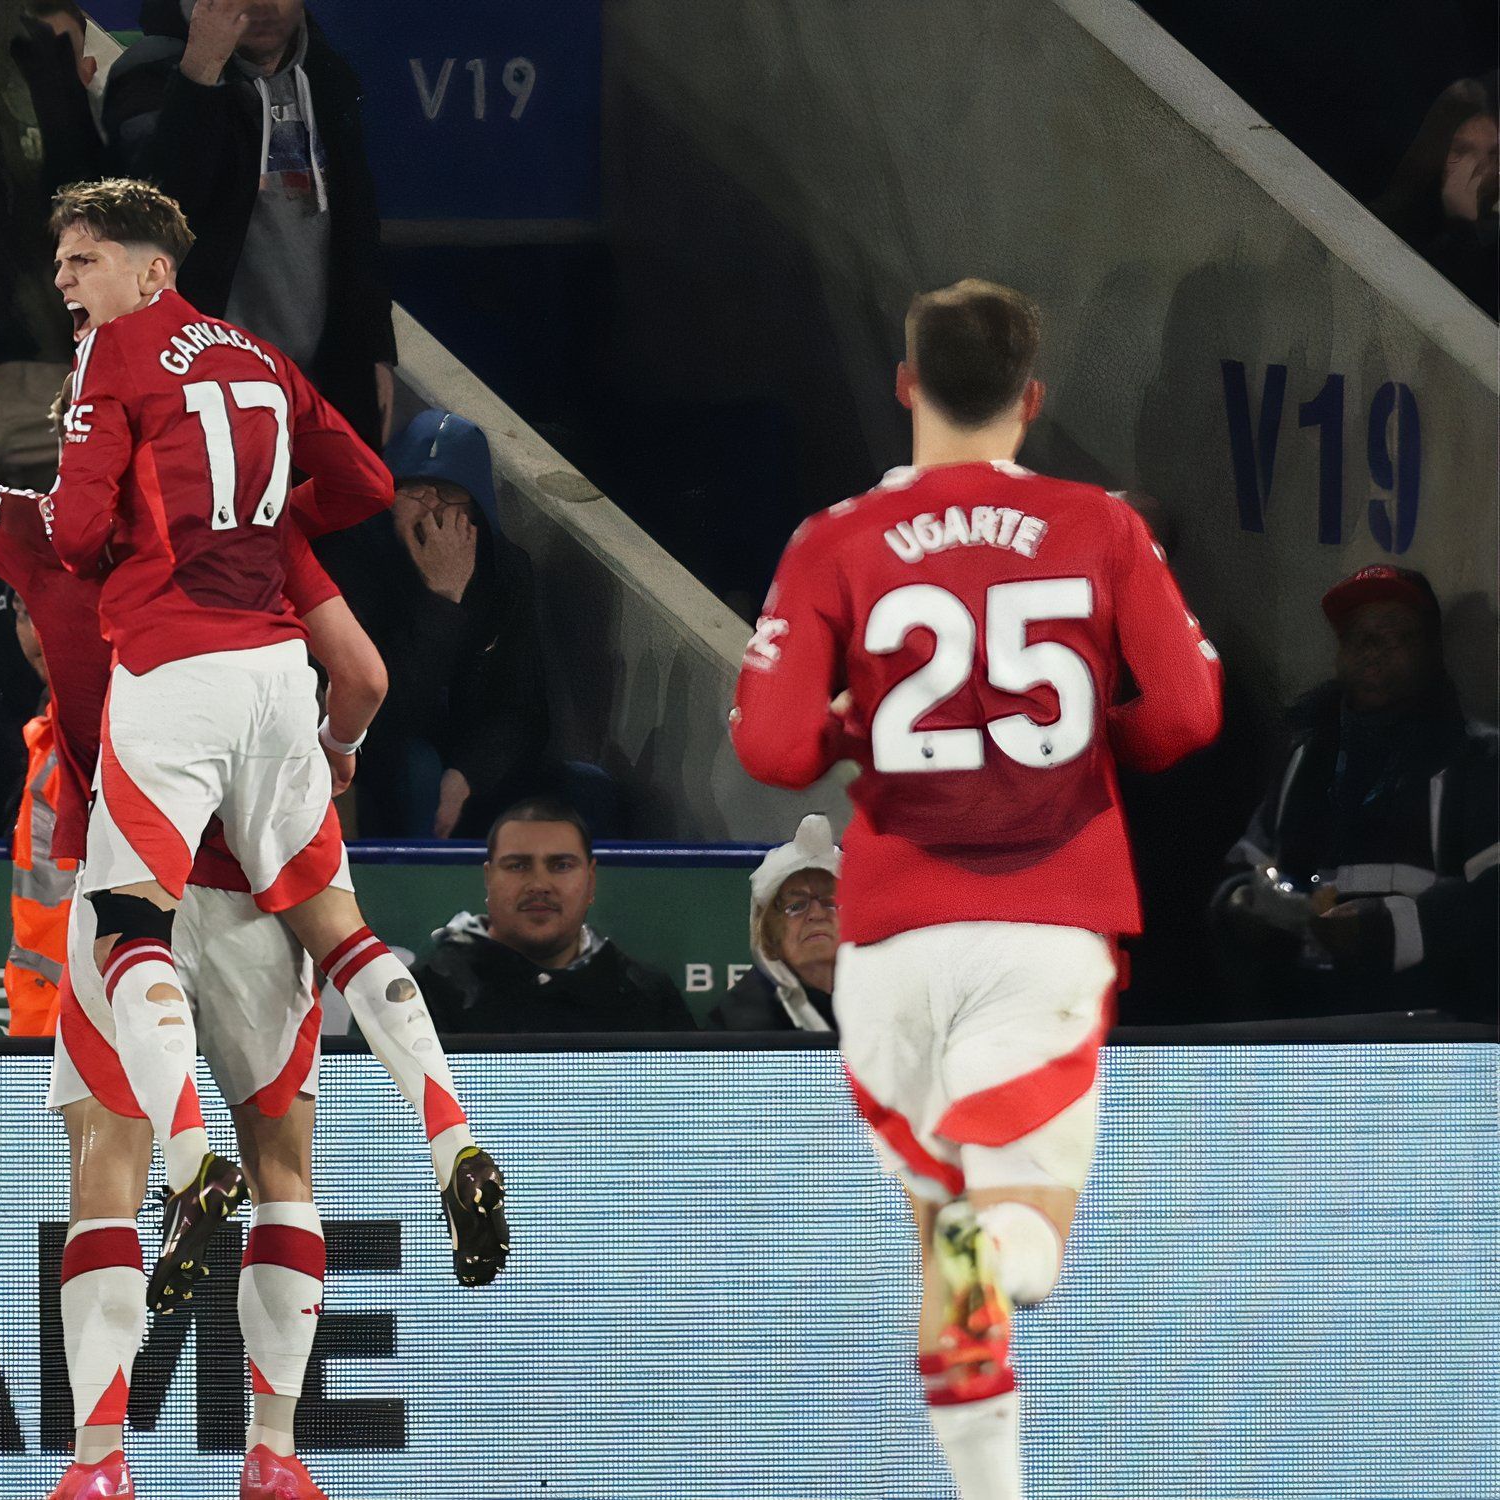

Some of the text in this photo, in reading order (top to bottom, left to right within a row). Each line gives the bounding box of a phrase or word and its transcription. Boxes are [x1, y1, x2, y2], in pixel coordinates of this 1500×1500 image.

[409, 56, 536, 120] V19
[182, 380, 291, 531] 17
[1220, 358, 1421, 555] V19
[884, 505, 1049, 564] UGARTE
[864, 577, 1095, 773] 25
